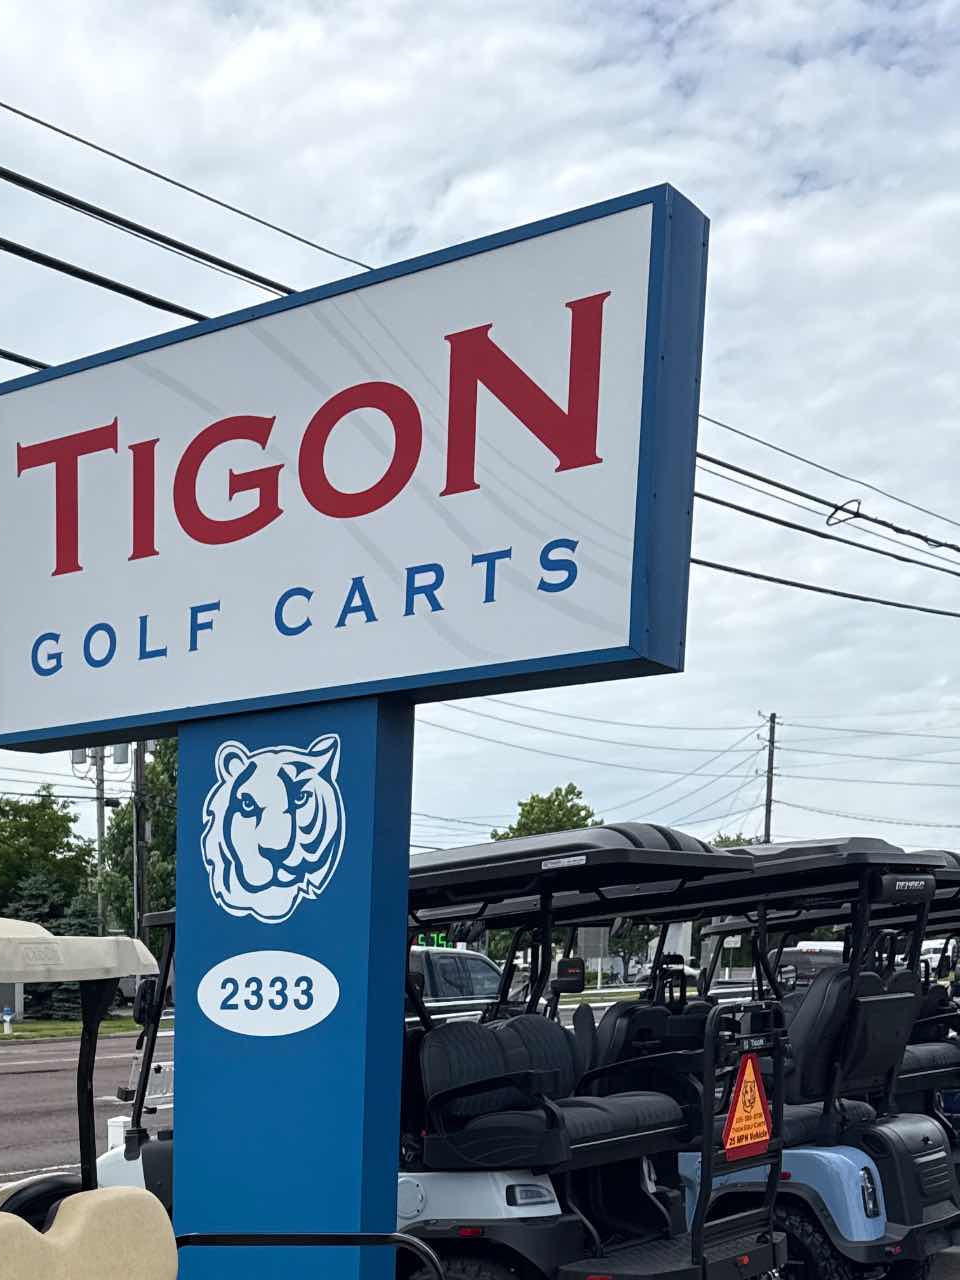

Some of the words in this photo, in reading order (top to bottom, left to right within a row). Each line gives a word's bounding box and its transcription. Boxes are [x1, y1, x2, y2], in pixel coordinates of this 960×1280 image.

[17, 292, 610, 577] TIGON
[31, 601, 221, 677] GOLF
[274, 539, 579, 636] CARTS
[219, 976, 314, 1010] 2333
